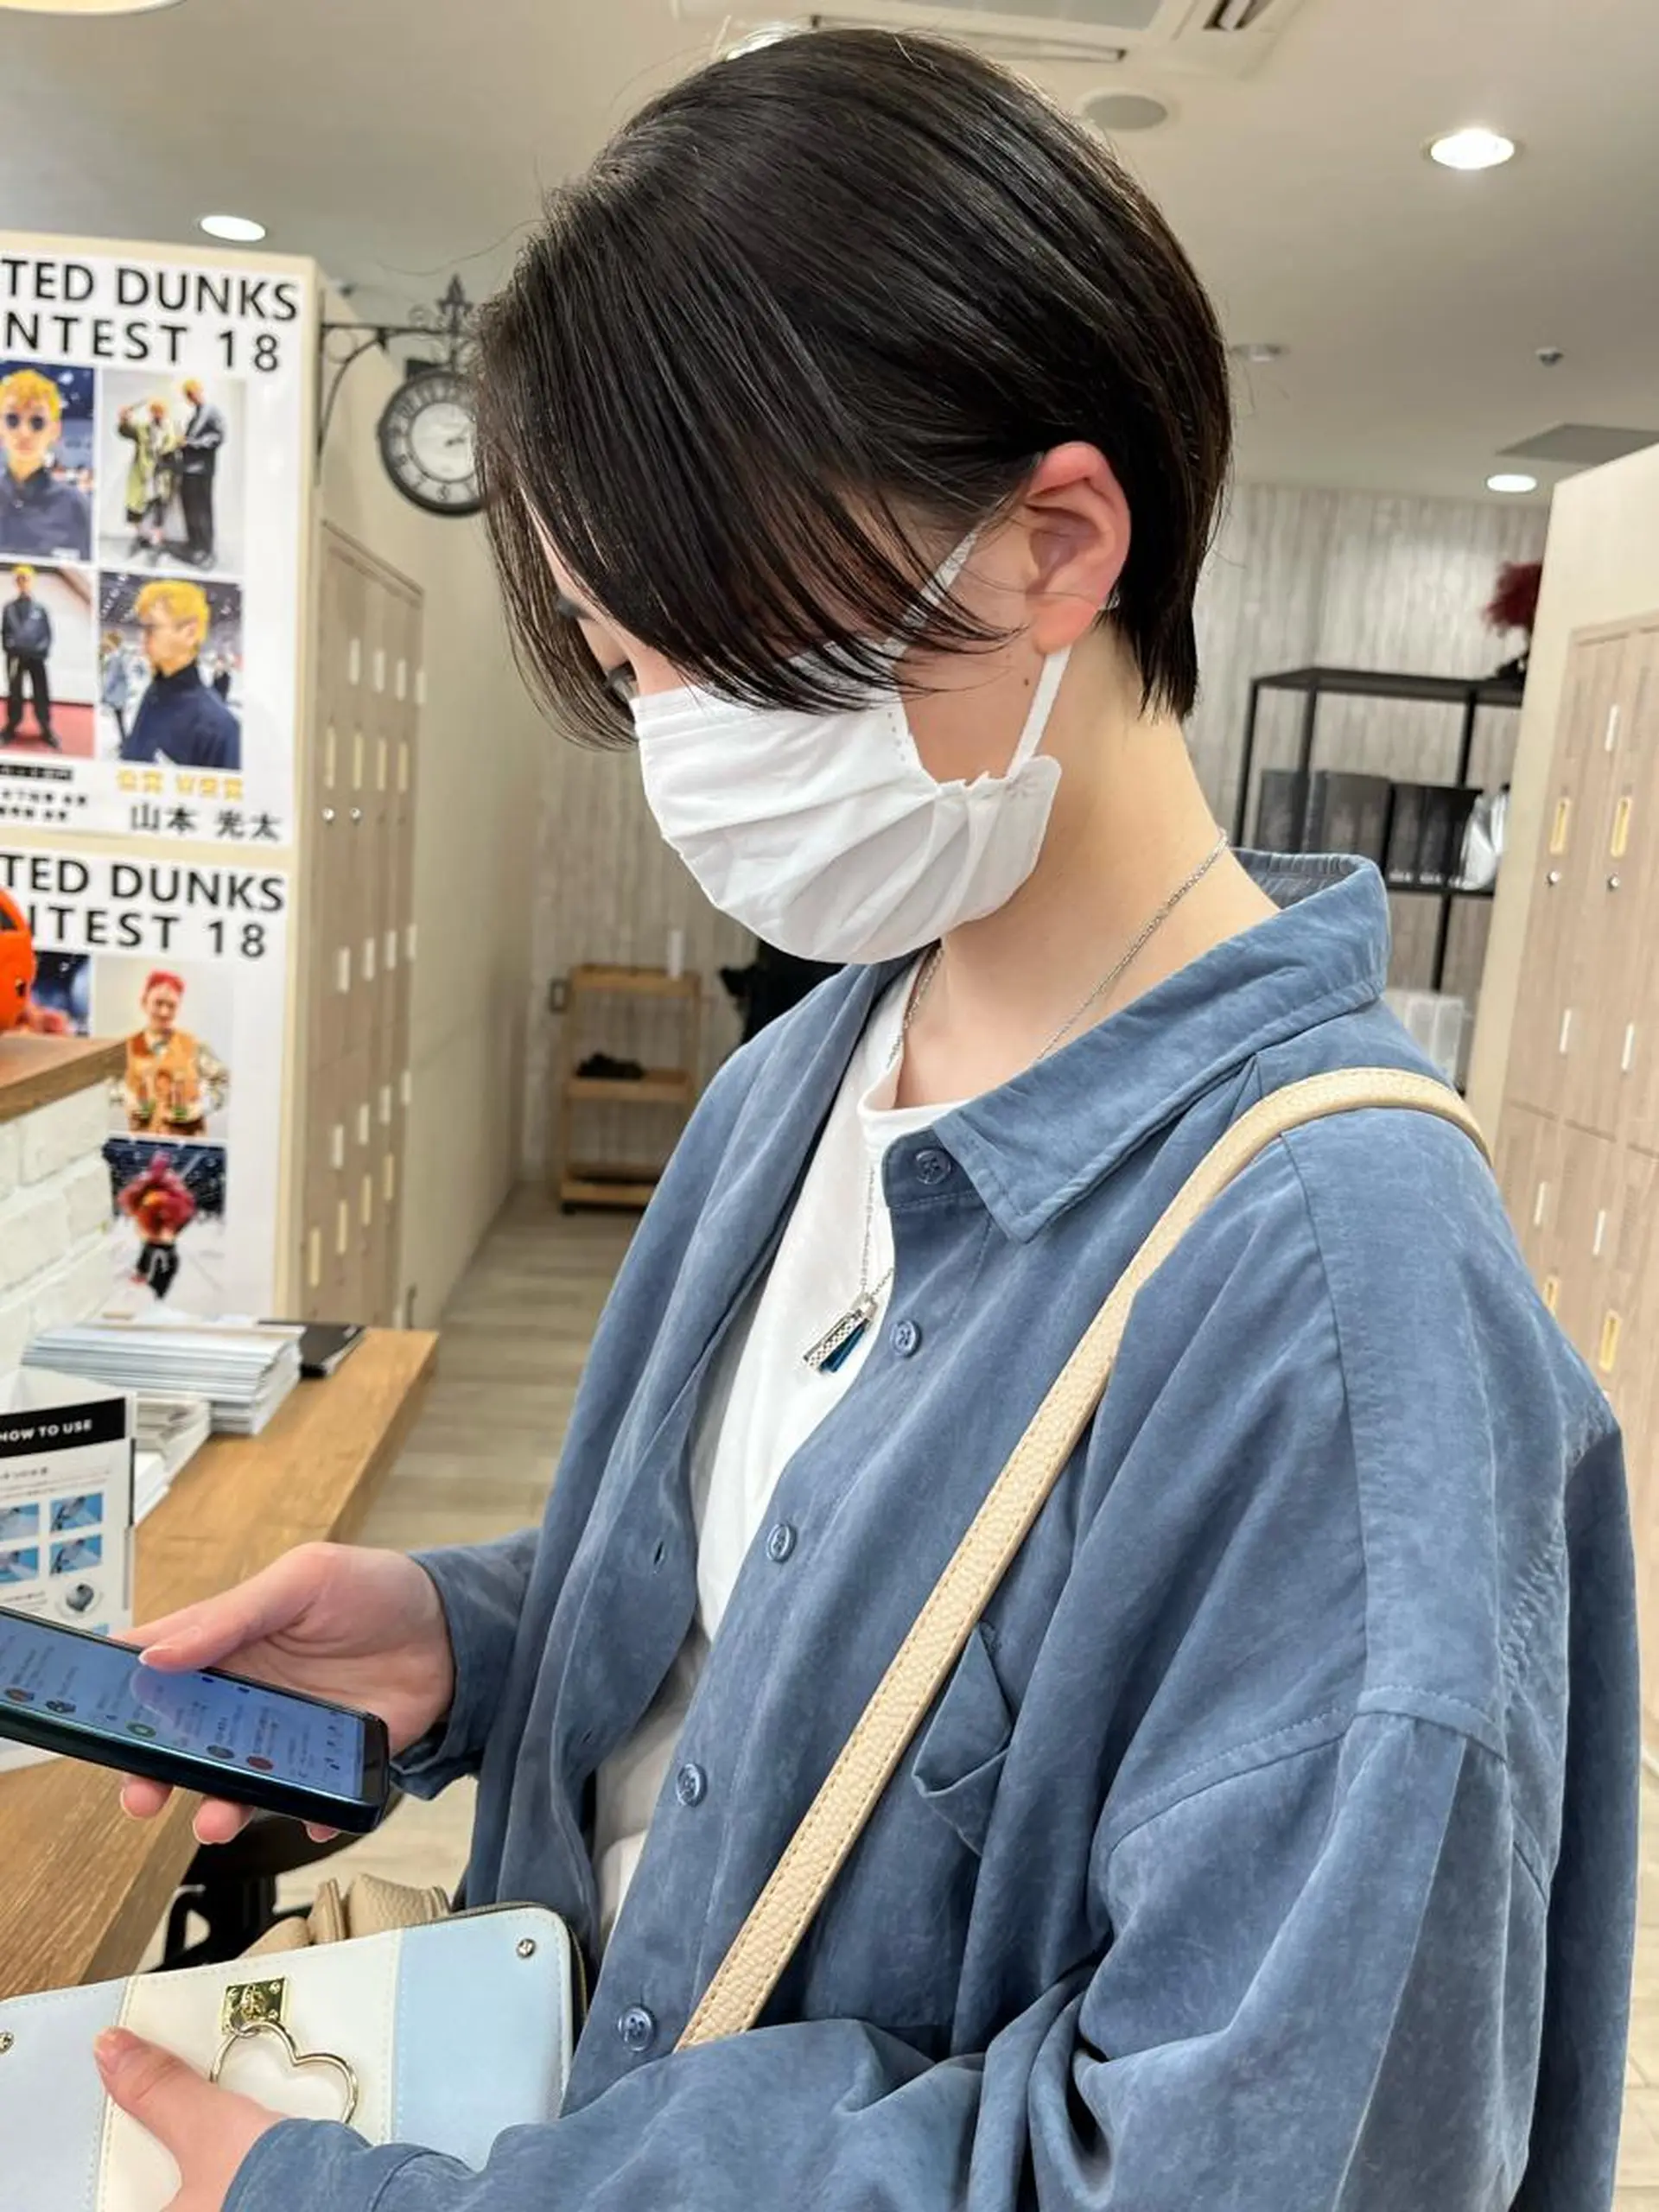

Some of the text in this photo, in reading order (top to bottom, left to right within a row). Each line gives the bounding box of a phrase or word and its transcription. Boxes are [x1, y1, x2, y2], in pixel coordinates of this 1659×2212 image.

[1, 258, 298, 321] TED DUNKS
[5, 312, 278, 372] NTEST 18
[130, 803, 198, 834] 山本
[0, 854, 283, 912] TED DUNKS
[208, 921, 265, 958] 18
[38, 1423, 60, 1437] TO
[62, 1419, 92, 1434] USE
